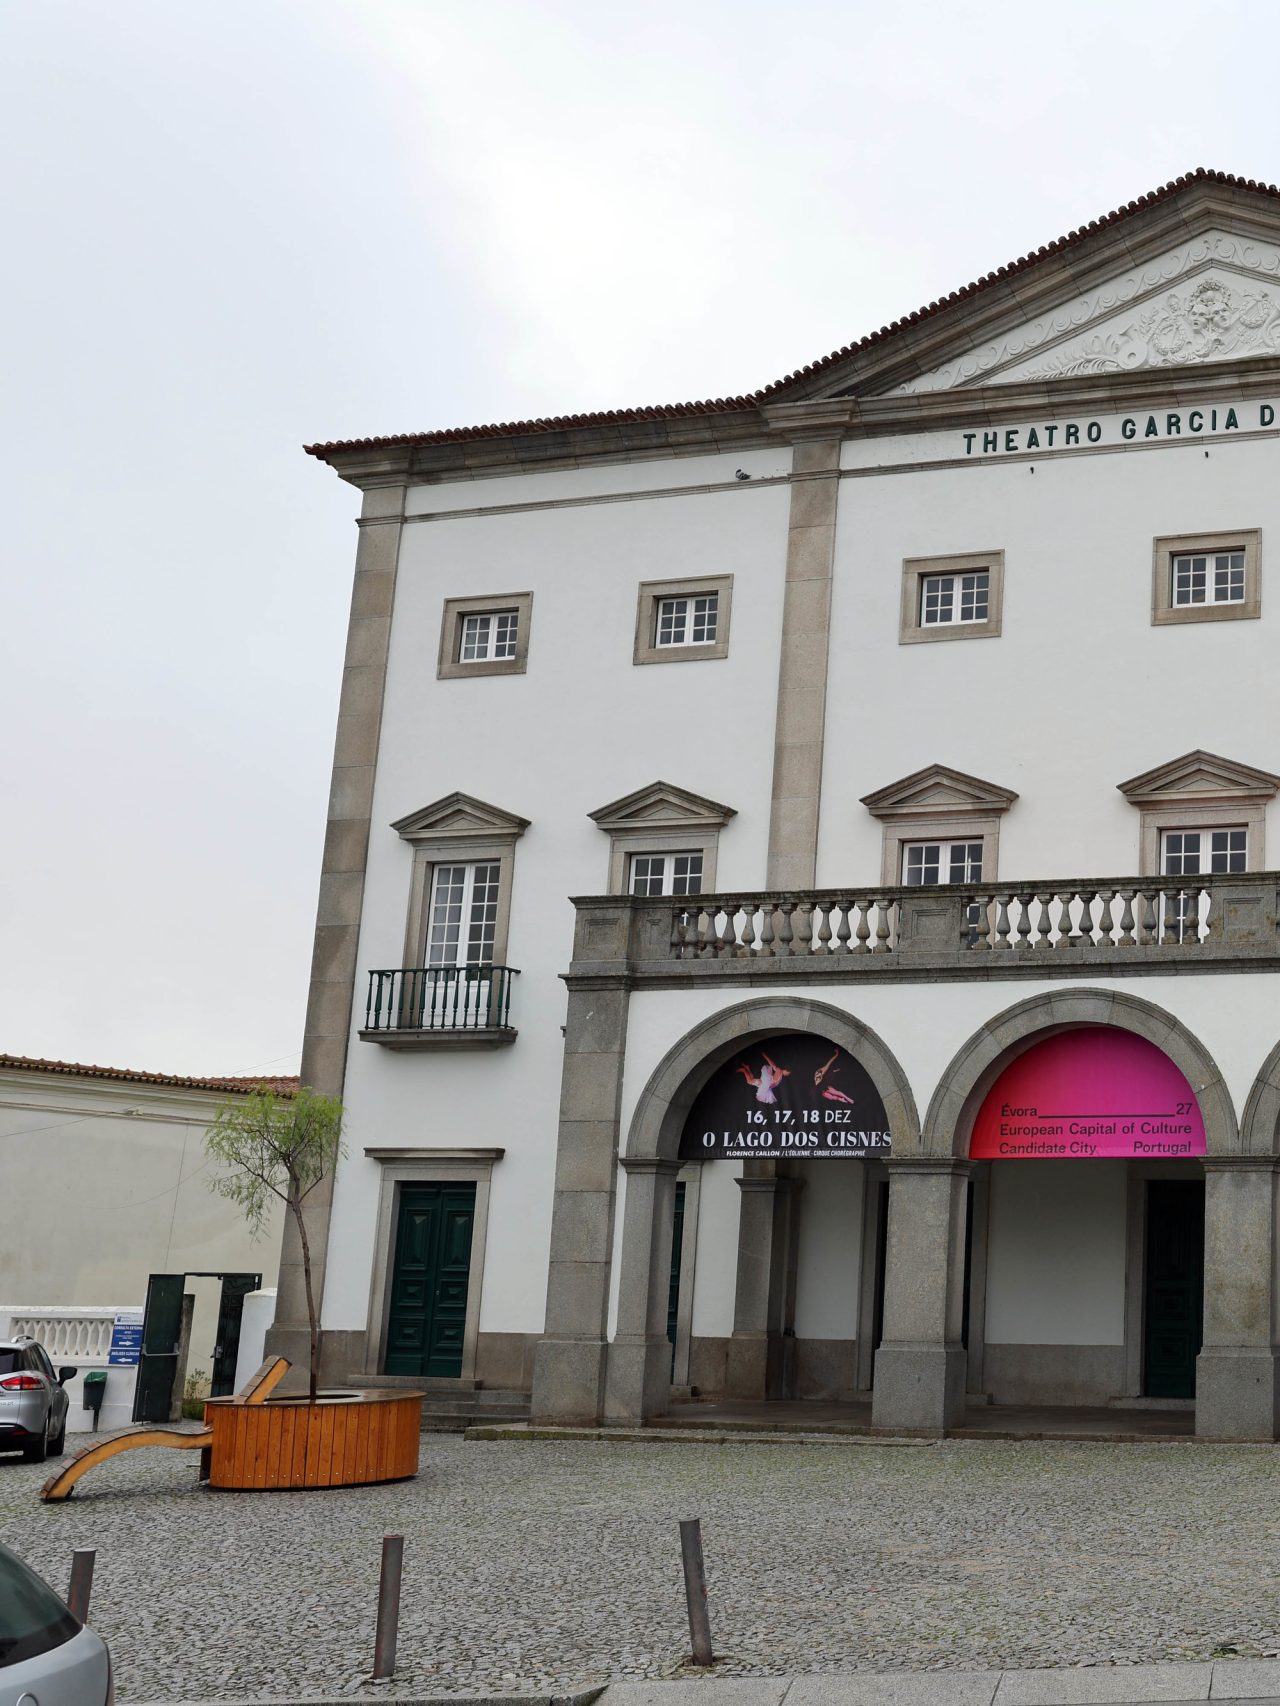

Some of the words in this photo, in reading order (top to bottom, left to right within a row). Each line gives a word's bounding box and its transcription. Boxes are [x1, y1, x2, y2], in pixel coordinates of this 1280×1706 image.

[963, 420, 1103, 454] THEATRO
[1121, 407, 1240, 440] GARCIA
[746, 1110, 768, 1126] 16,
[774, 1110, 796, 1126] 17,
[802, 1110, 820, 1124] 18
[825, 1110, 851, 1123] DEZ
[1001, 1103, 1038, 1117] Évora
[1175, 1103, 1193, 1116] 27
[1000, 1123, 1064, 1137] European
[1069, 1122, 1117, 1137] Capital
[1121, 1122, 1135, 1135] of
[1140, 1121, 1193, 1134] Culture
[702, 1131, 716, 1147] O
[722, 1131, 773, 1147] LAGO
[780, 1131, 819, 1147] DOS
[826, 1131, 892, 1147] CISNES
[1000, 1142, 1066, 1154] Candidate
[1070, 1141, 1097, 1156] City
[1133, 1141, 1192, 1155] Portugal
